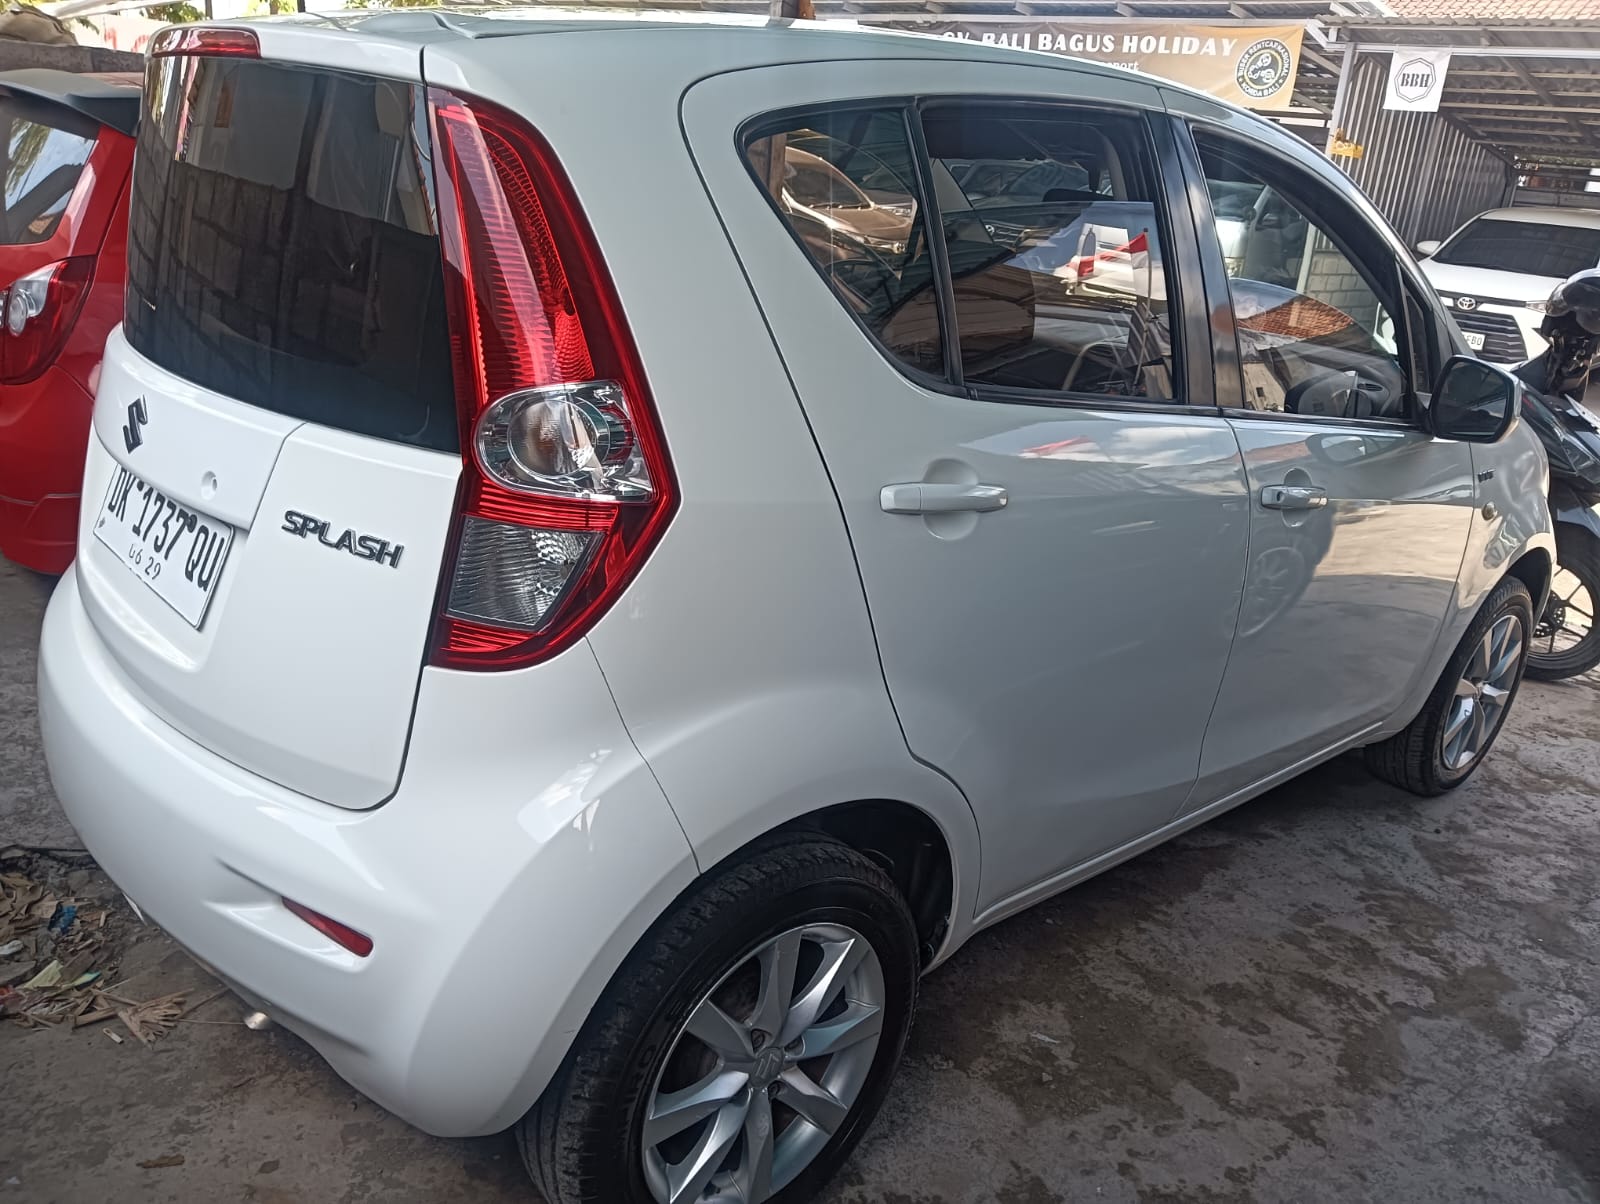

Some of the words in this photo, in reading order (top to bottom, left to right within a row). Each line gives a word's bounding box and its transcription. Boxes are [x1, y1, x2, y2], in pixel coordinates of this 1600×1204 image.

[981, 32, 1031, 50] BALI
[1038, 33, 1115, 53] BAGUS
[1121, 35, 1238, 57] HOLIDAY
[1400, 73, 1431, 88] BBH
[107, 466, 137, 522] DK
[132, 486, 190, 561] 1737
[185, 524, 225, 592] QU
[281, 509, 405, 569] SPLASH
[144, 556, 162, 580] 29
